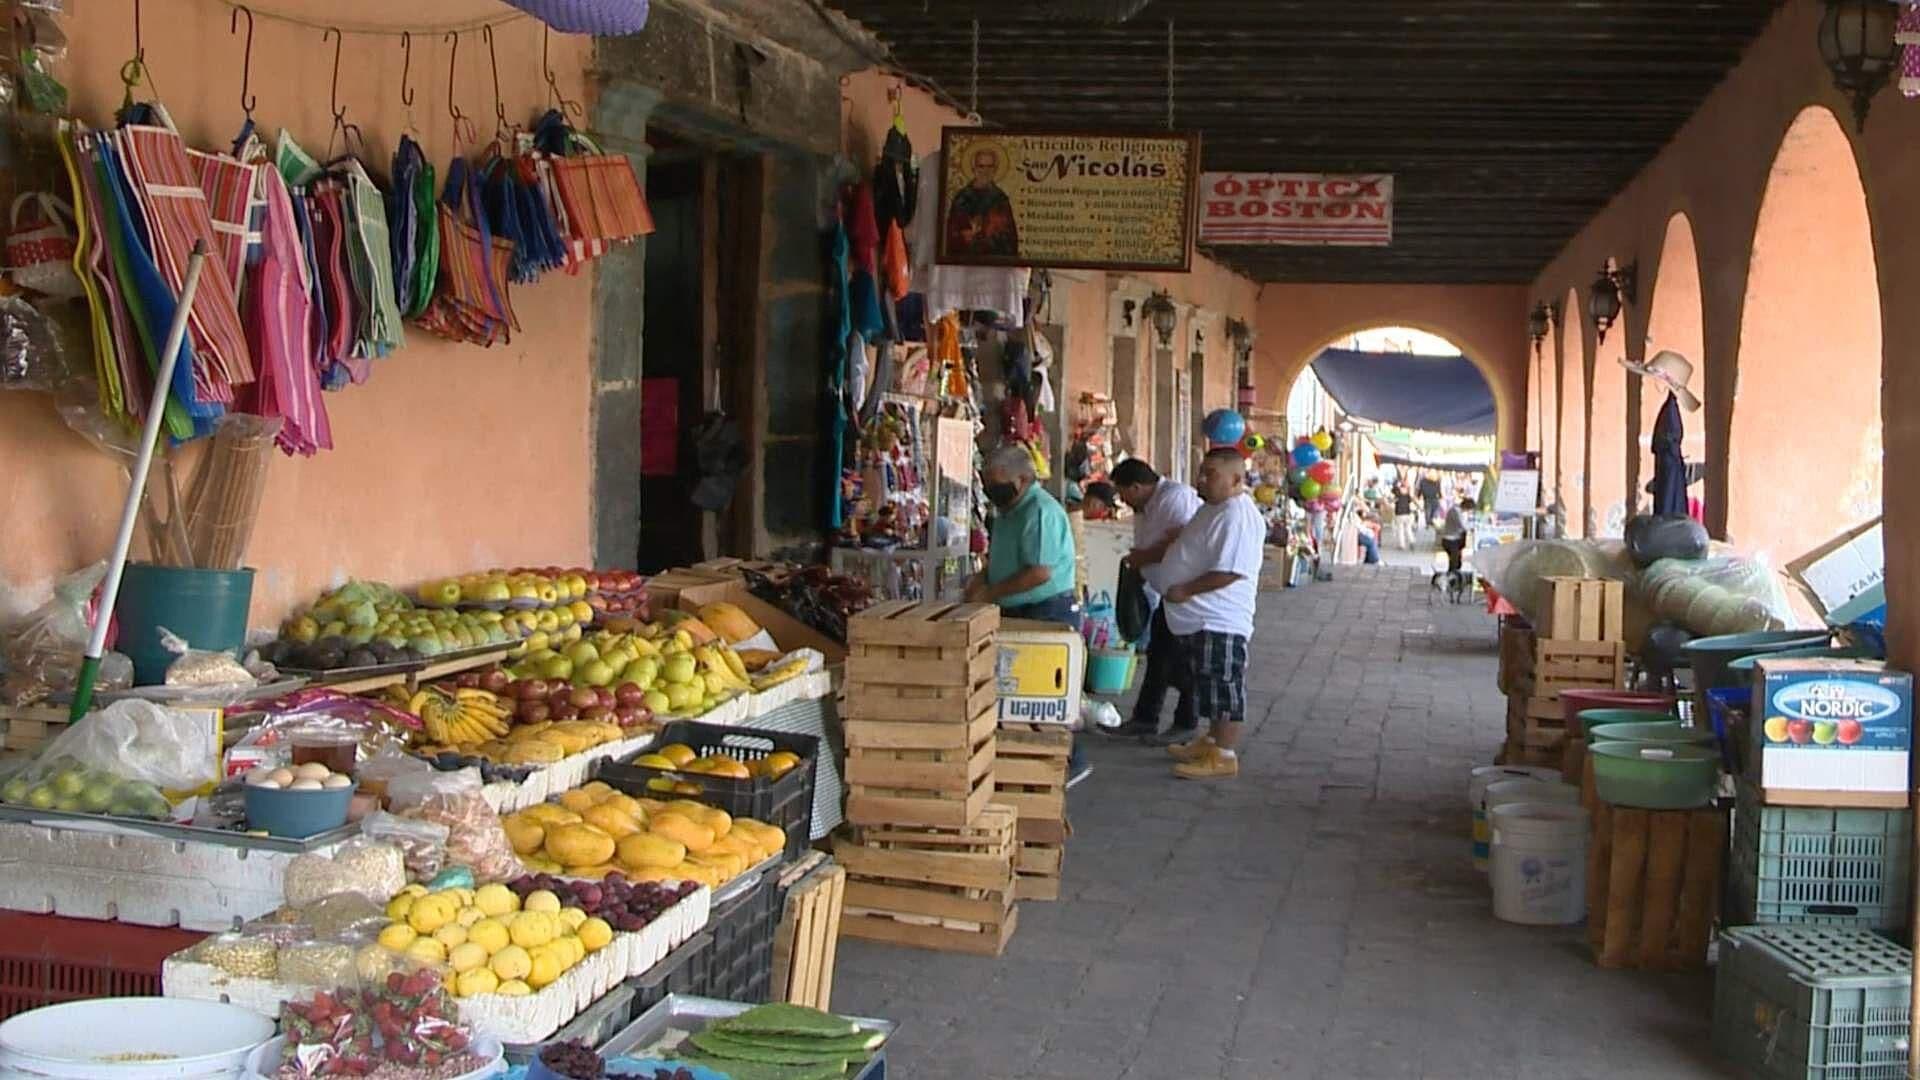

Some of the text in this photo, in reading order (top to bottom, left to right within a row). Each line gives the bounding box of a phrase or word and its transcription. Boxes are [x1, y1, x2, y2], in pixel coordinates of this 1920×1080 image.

[1099, 139, 1186, 155] Religiosos
[1016, 153, 1167, 183] San Nicolás
[1213, 175, 1381, 198] ÓPTICA
[1206, 201, 1387, 219] BOSTON
[1010, 699, 1067, 721] Golden
[1800, 698, 1873, 718] NORDIC
